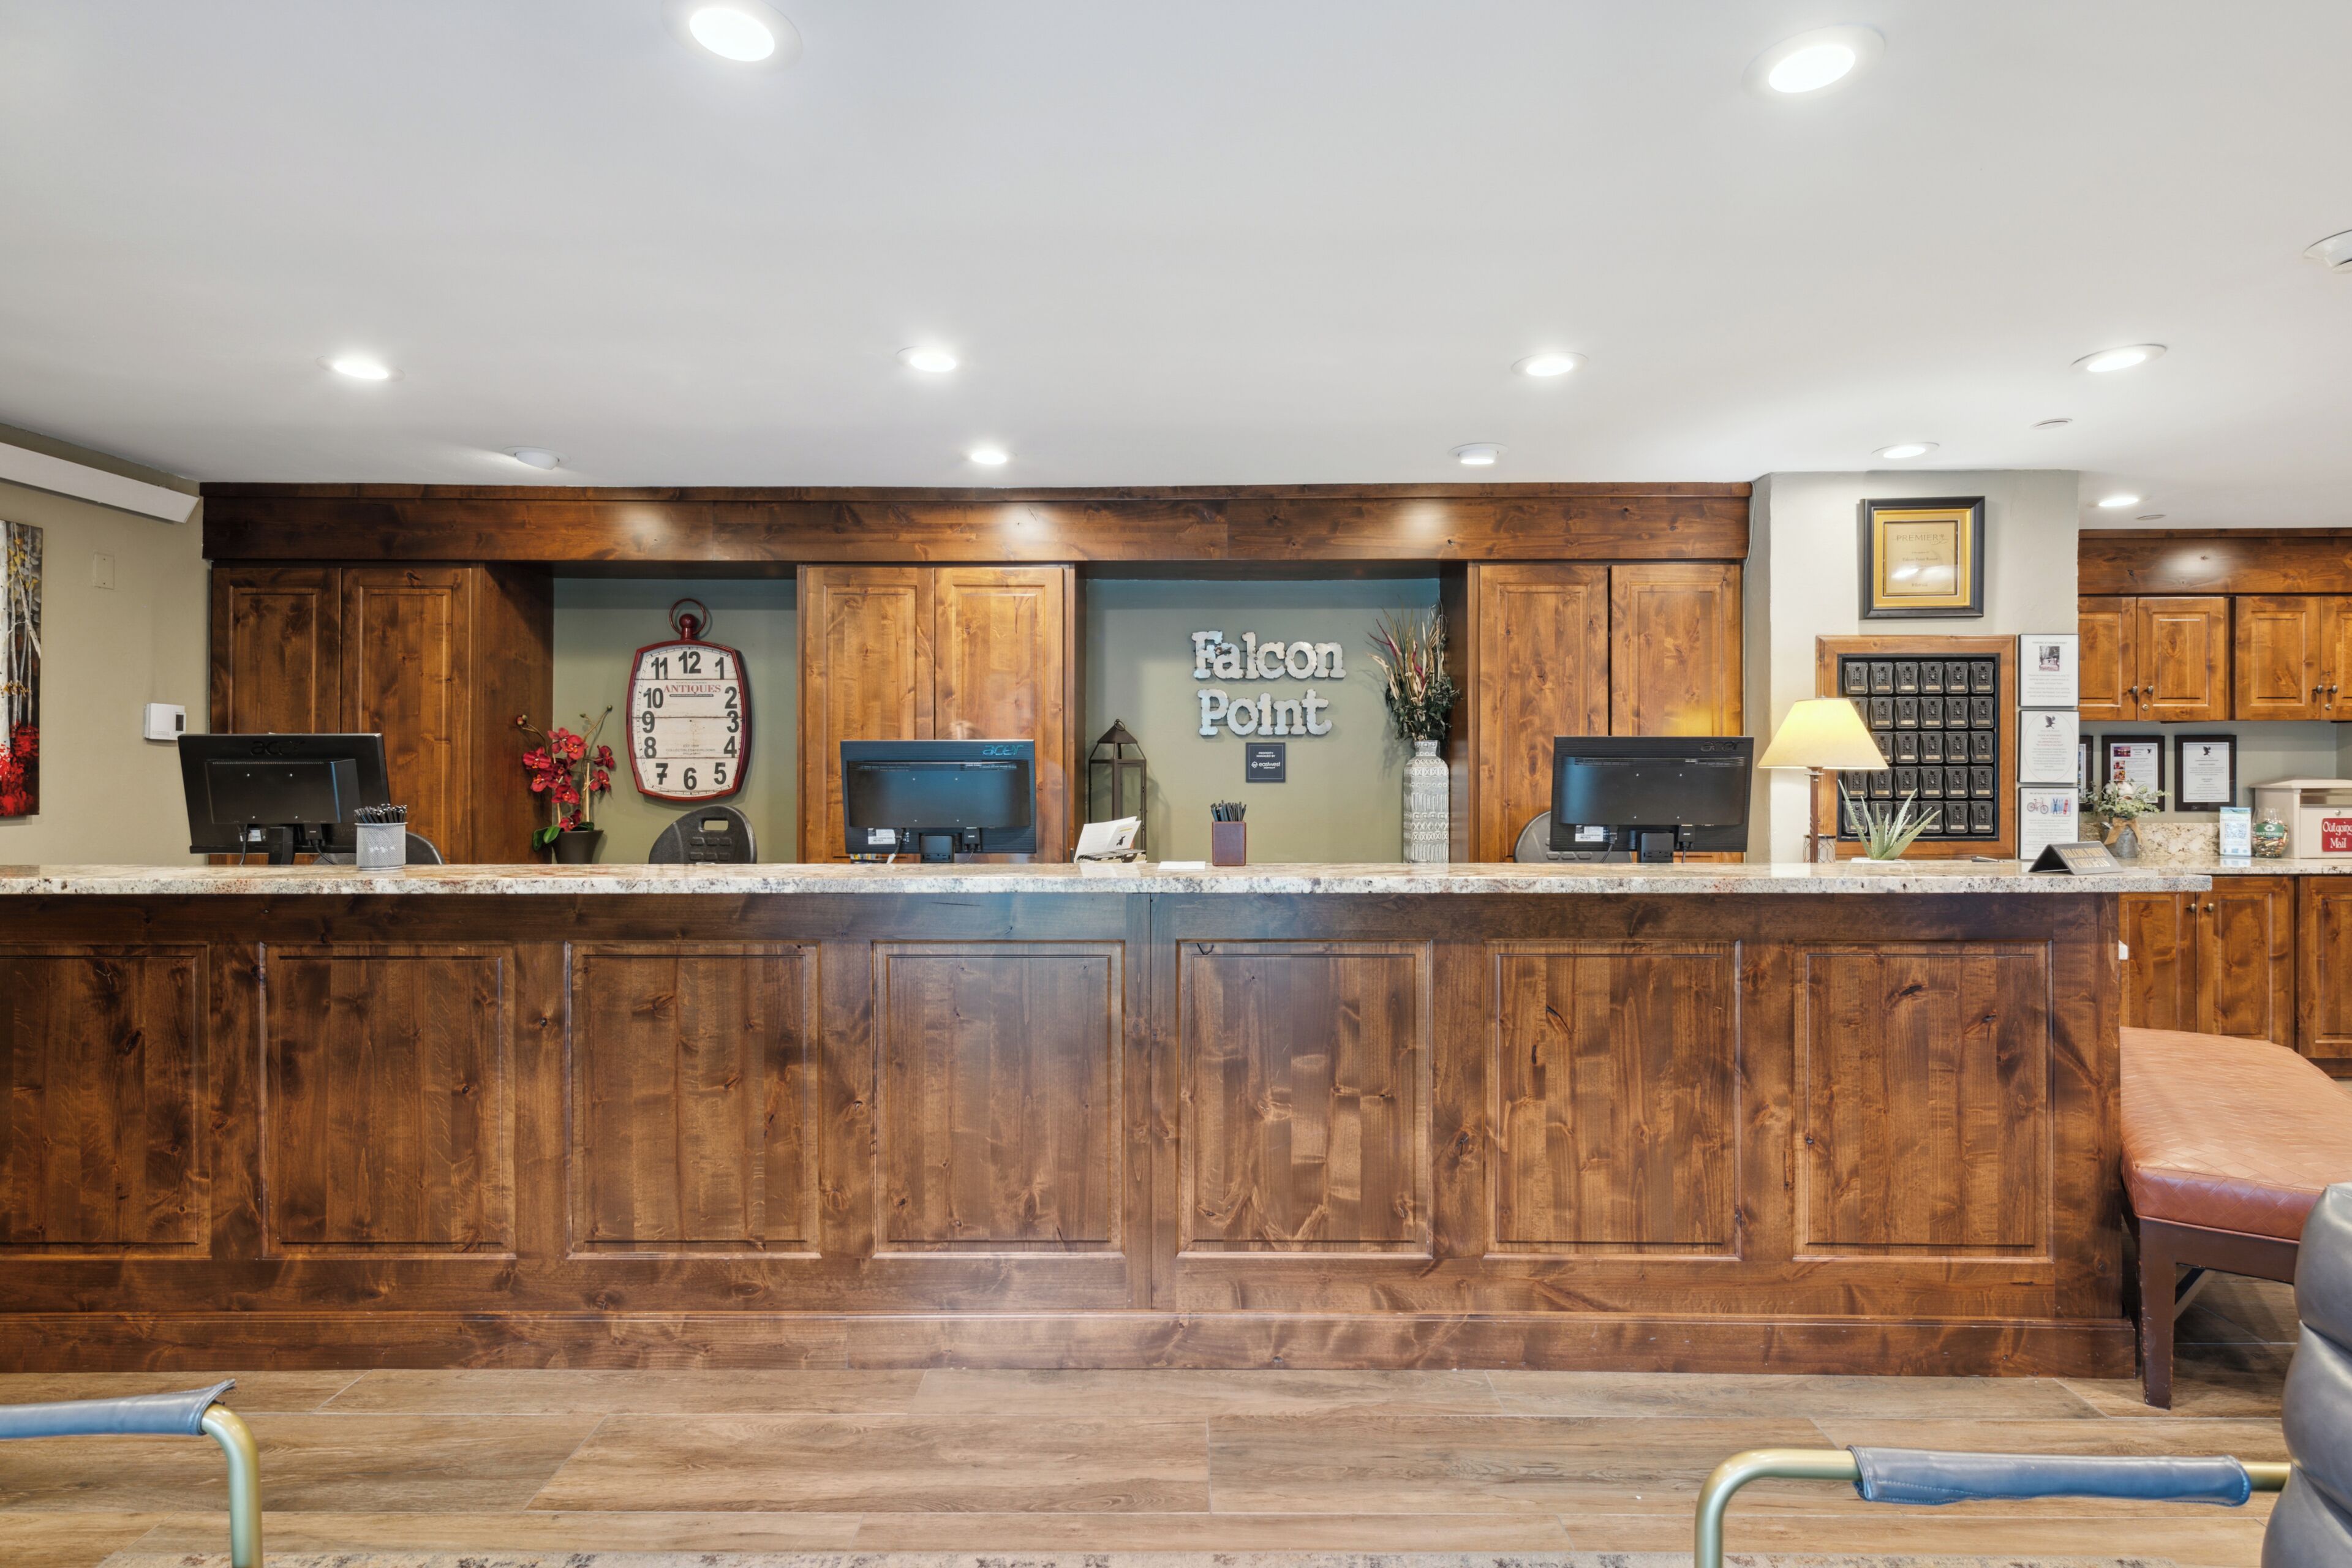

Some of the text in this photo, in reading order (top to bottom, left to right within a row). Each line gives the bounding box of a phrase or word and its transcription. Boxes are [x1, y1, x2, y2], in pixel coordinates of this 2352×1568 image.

[678, 651, 701, 674] 12
[1191, 630, 1347, 679] Falcon
[651, 657, 668, 680] 11
[715, 657, 725, 680] 1
[643, 687, 663, 709] 10
[663, 685, 722, 695] ANTIQUES
[725, 686, 737, 709] 2
[642, 710, 655, 733] 9
[726, 710, 739, 733] 3
[1197, 688, 1333, 735] Point
[644, 737, 657, 759] 8
[723, 736, 737, 758] 4
[982, 744, 1025, 756] acer
[1700, 741, 1744, 752] acer
[655, 763, 668, 785] 7
[684, 767, 697, 790] 6
[714, 762, 727, 785] 5
[2323, 821, 2352, 836] Outgoing
[2330, 837, 2346, 848] Mail
